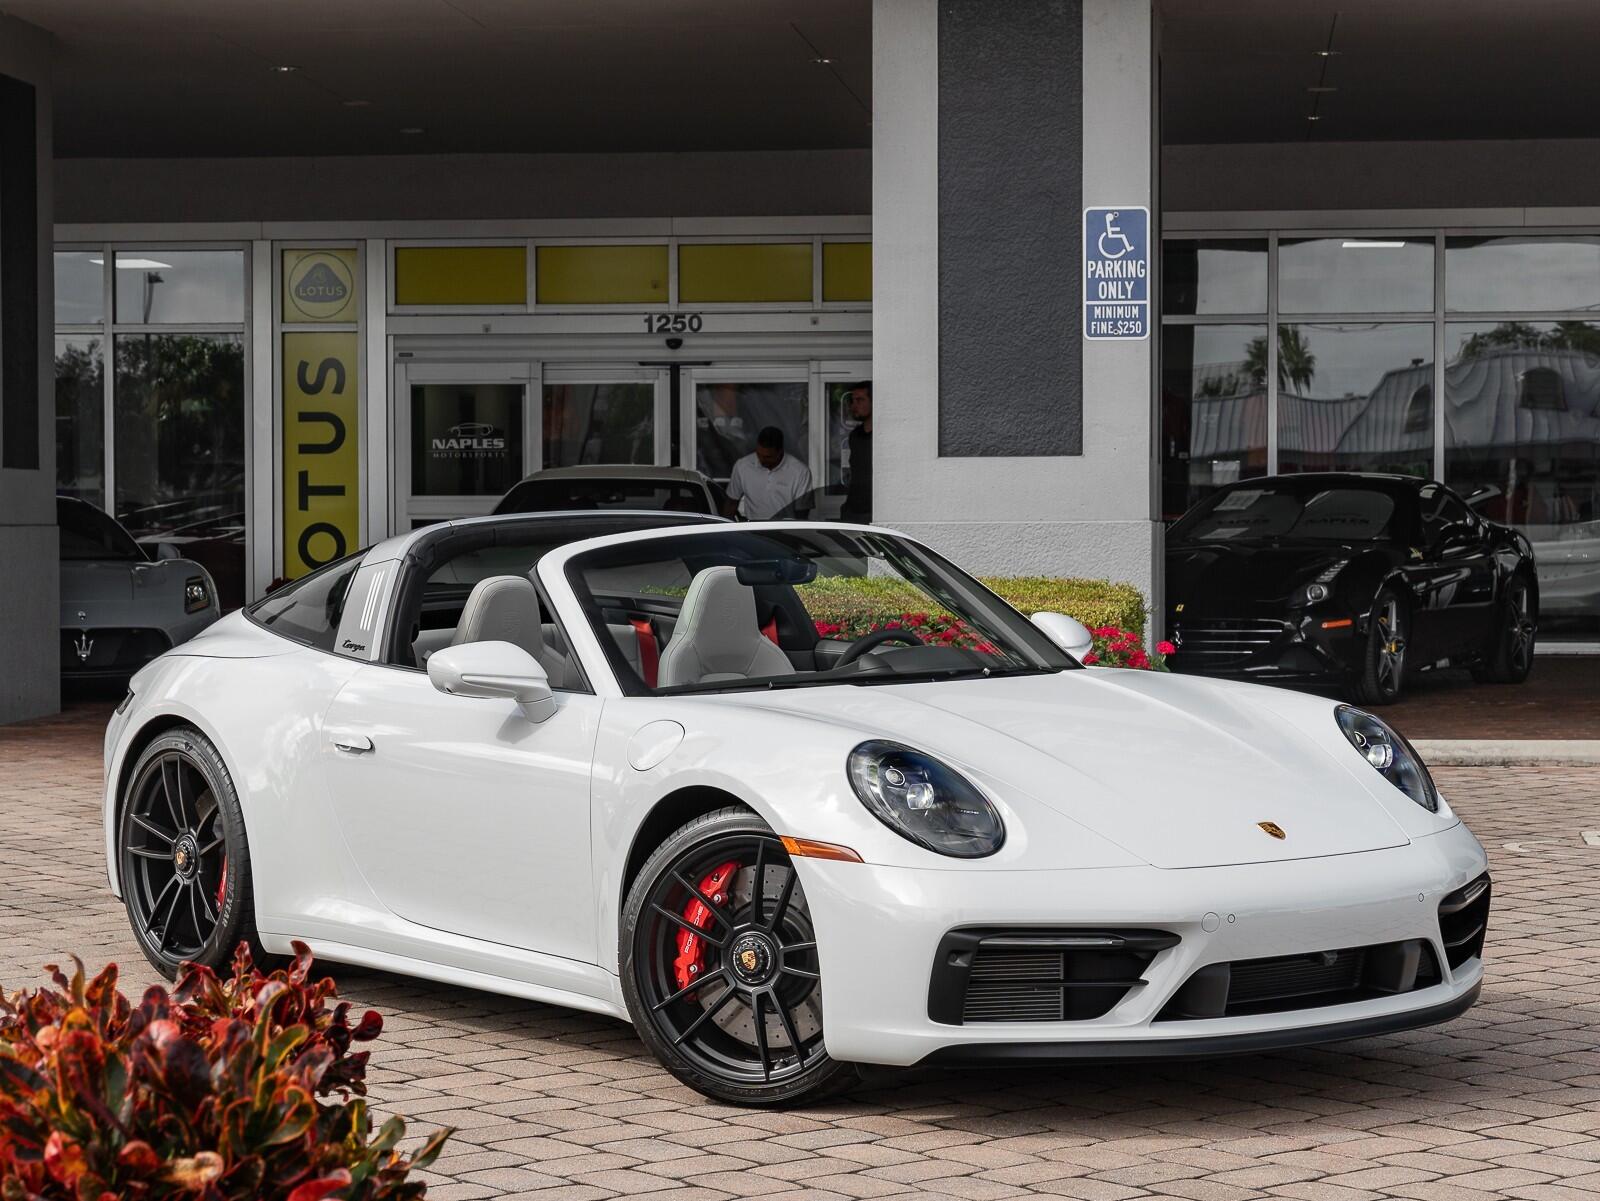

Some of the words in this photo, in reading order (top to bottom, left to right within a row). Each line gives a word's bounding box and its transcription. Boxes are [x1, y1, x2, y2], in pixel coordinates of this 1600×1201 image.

[1087, 260, 1146, 279] PARKING
[299, 286, 343, 296] LOTUS
[1098, 281, 1135, 299] ONLY
[1094, 306, 1139, 319] MINIMUM
[644, 314, 703, 333] 1250
[1091, 321, 1114, 334] FINE
[1117, 320, 1142, 335] $250
[432, 438, 505, 449] NAPLES
[684, 905, 704, 954] PORCHE
